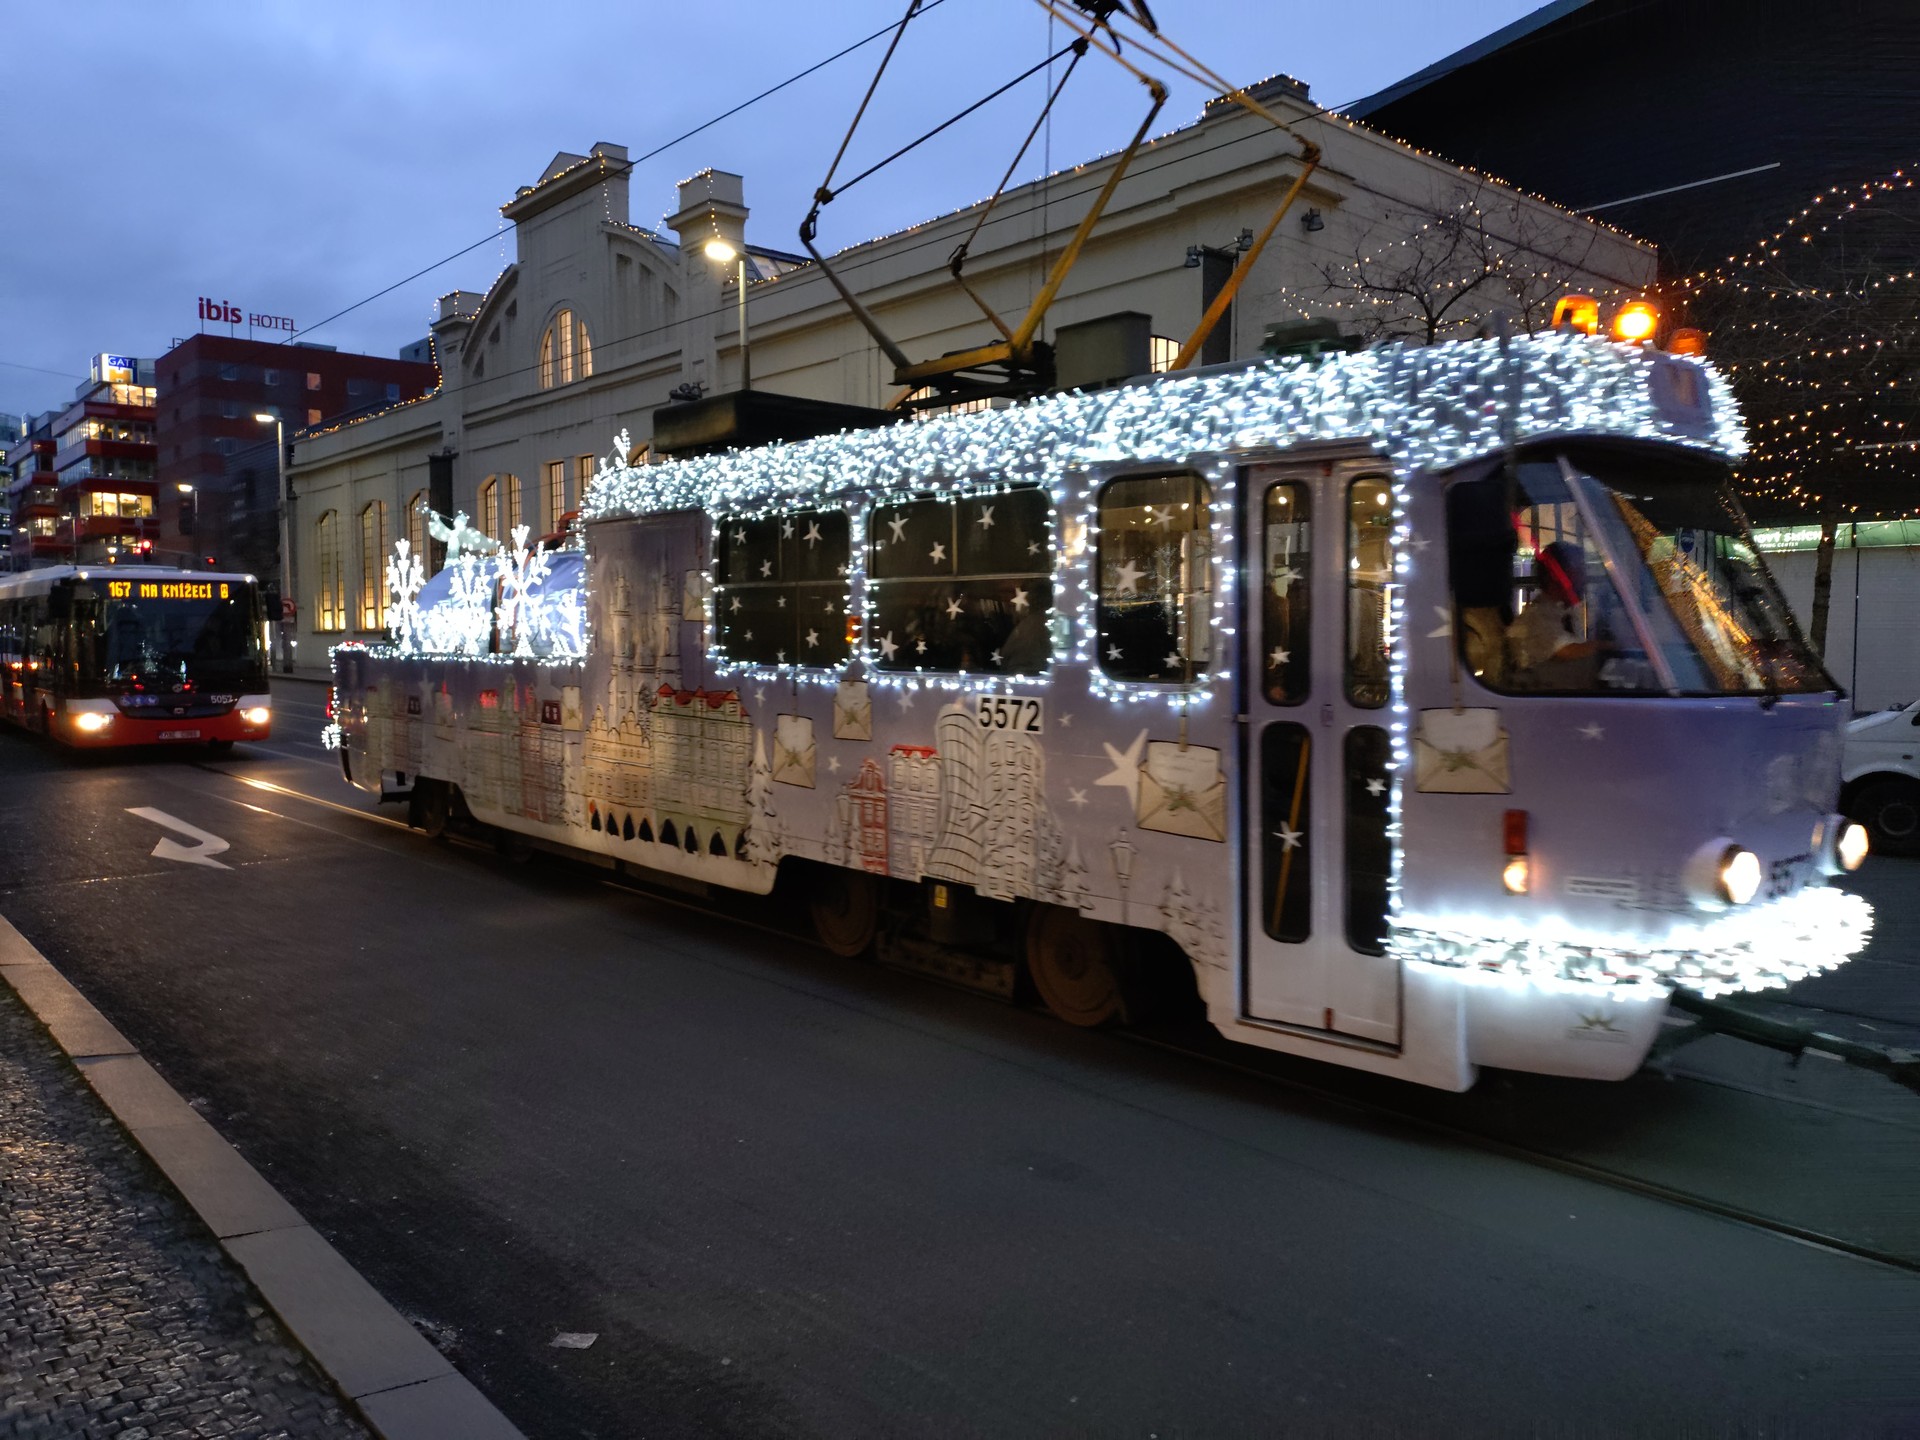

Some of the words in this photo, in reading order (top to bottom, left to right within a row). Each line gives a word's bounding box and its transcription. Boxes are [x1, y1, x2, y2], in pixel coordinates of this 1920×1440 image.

[199, 297, 242, 324] ibis
[249, 313, 299, 332] HOTEL
[109, 357, 137, 369] GATE
[108, 582, 131, 598] 167
[141, 584, 158, 598] NA
[162, 583, 212, 599] KNÍŽECÍ
[979, 697, 1040, 732] 5572
